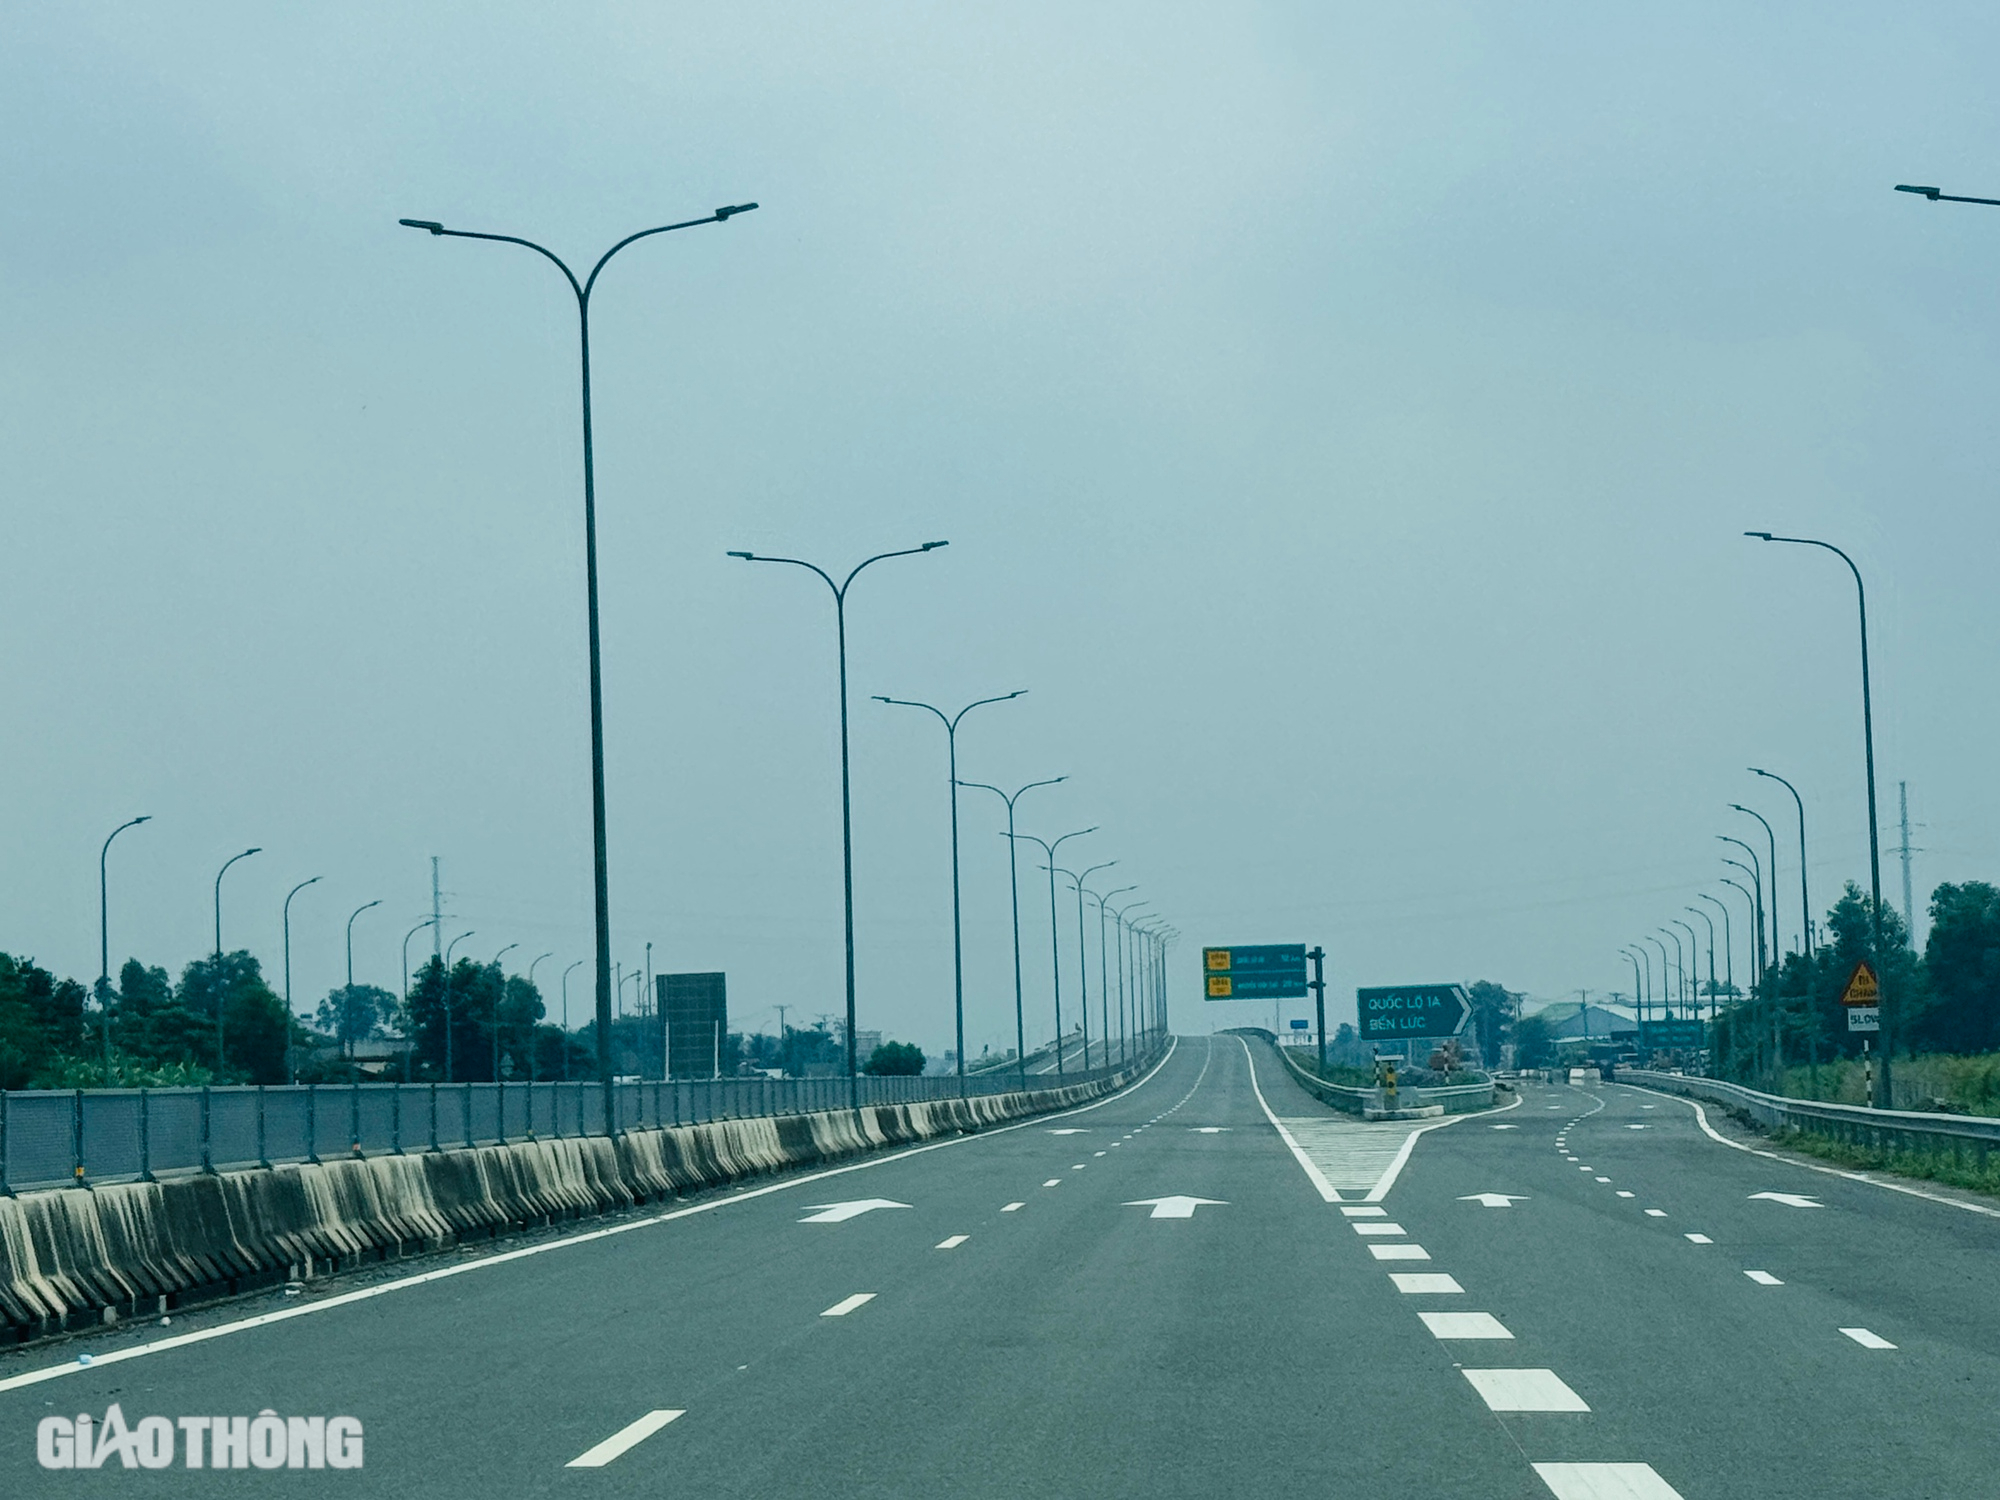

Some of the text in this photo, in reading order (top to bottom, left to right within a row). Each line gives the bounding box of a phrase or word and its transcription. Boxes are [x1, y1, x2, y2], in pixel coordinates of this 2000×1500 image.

[1368, 993, 1403, 1011] QUỐC
[1427, 996, 1441, 1008] 1A
[1369, 1015, 1396, 1031] BẾN
